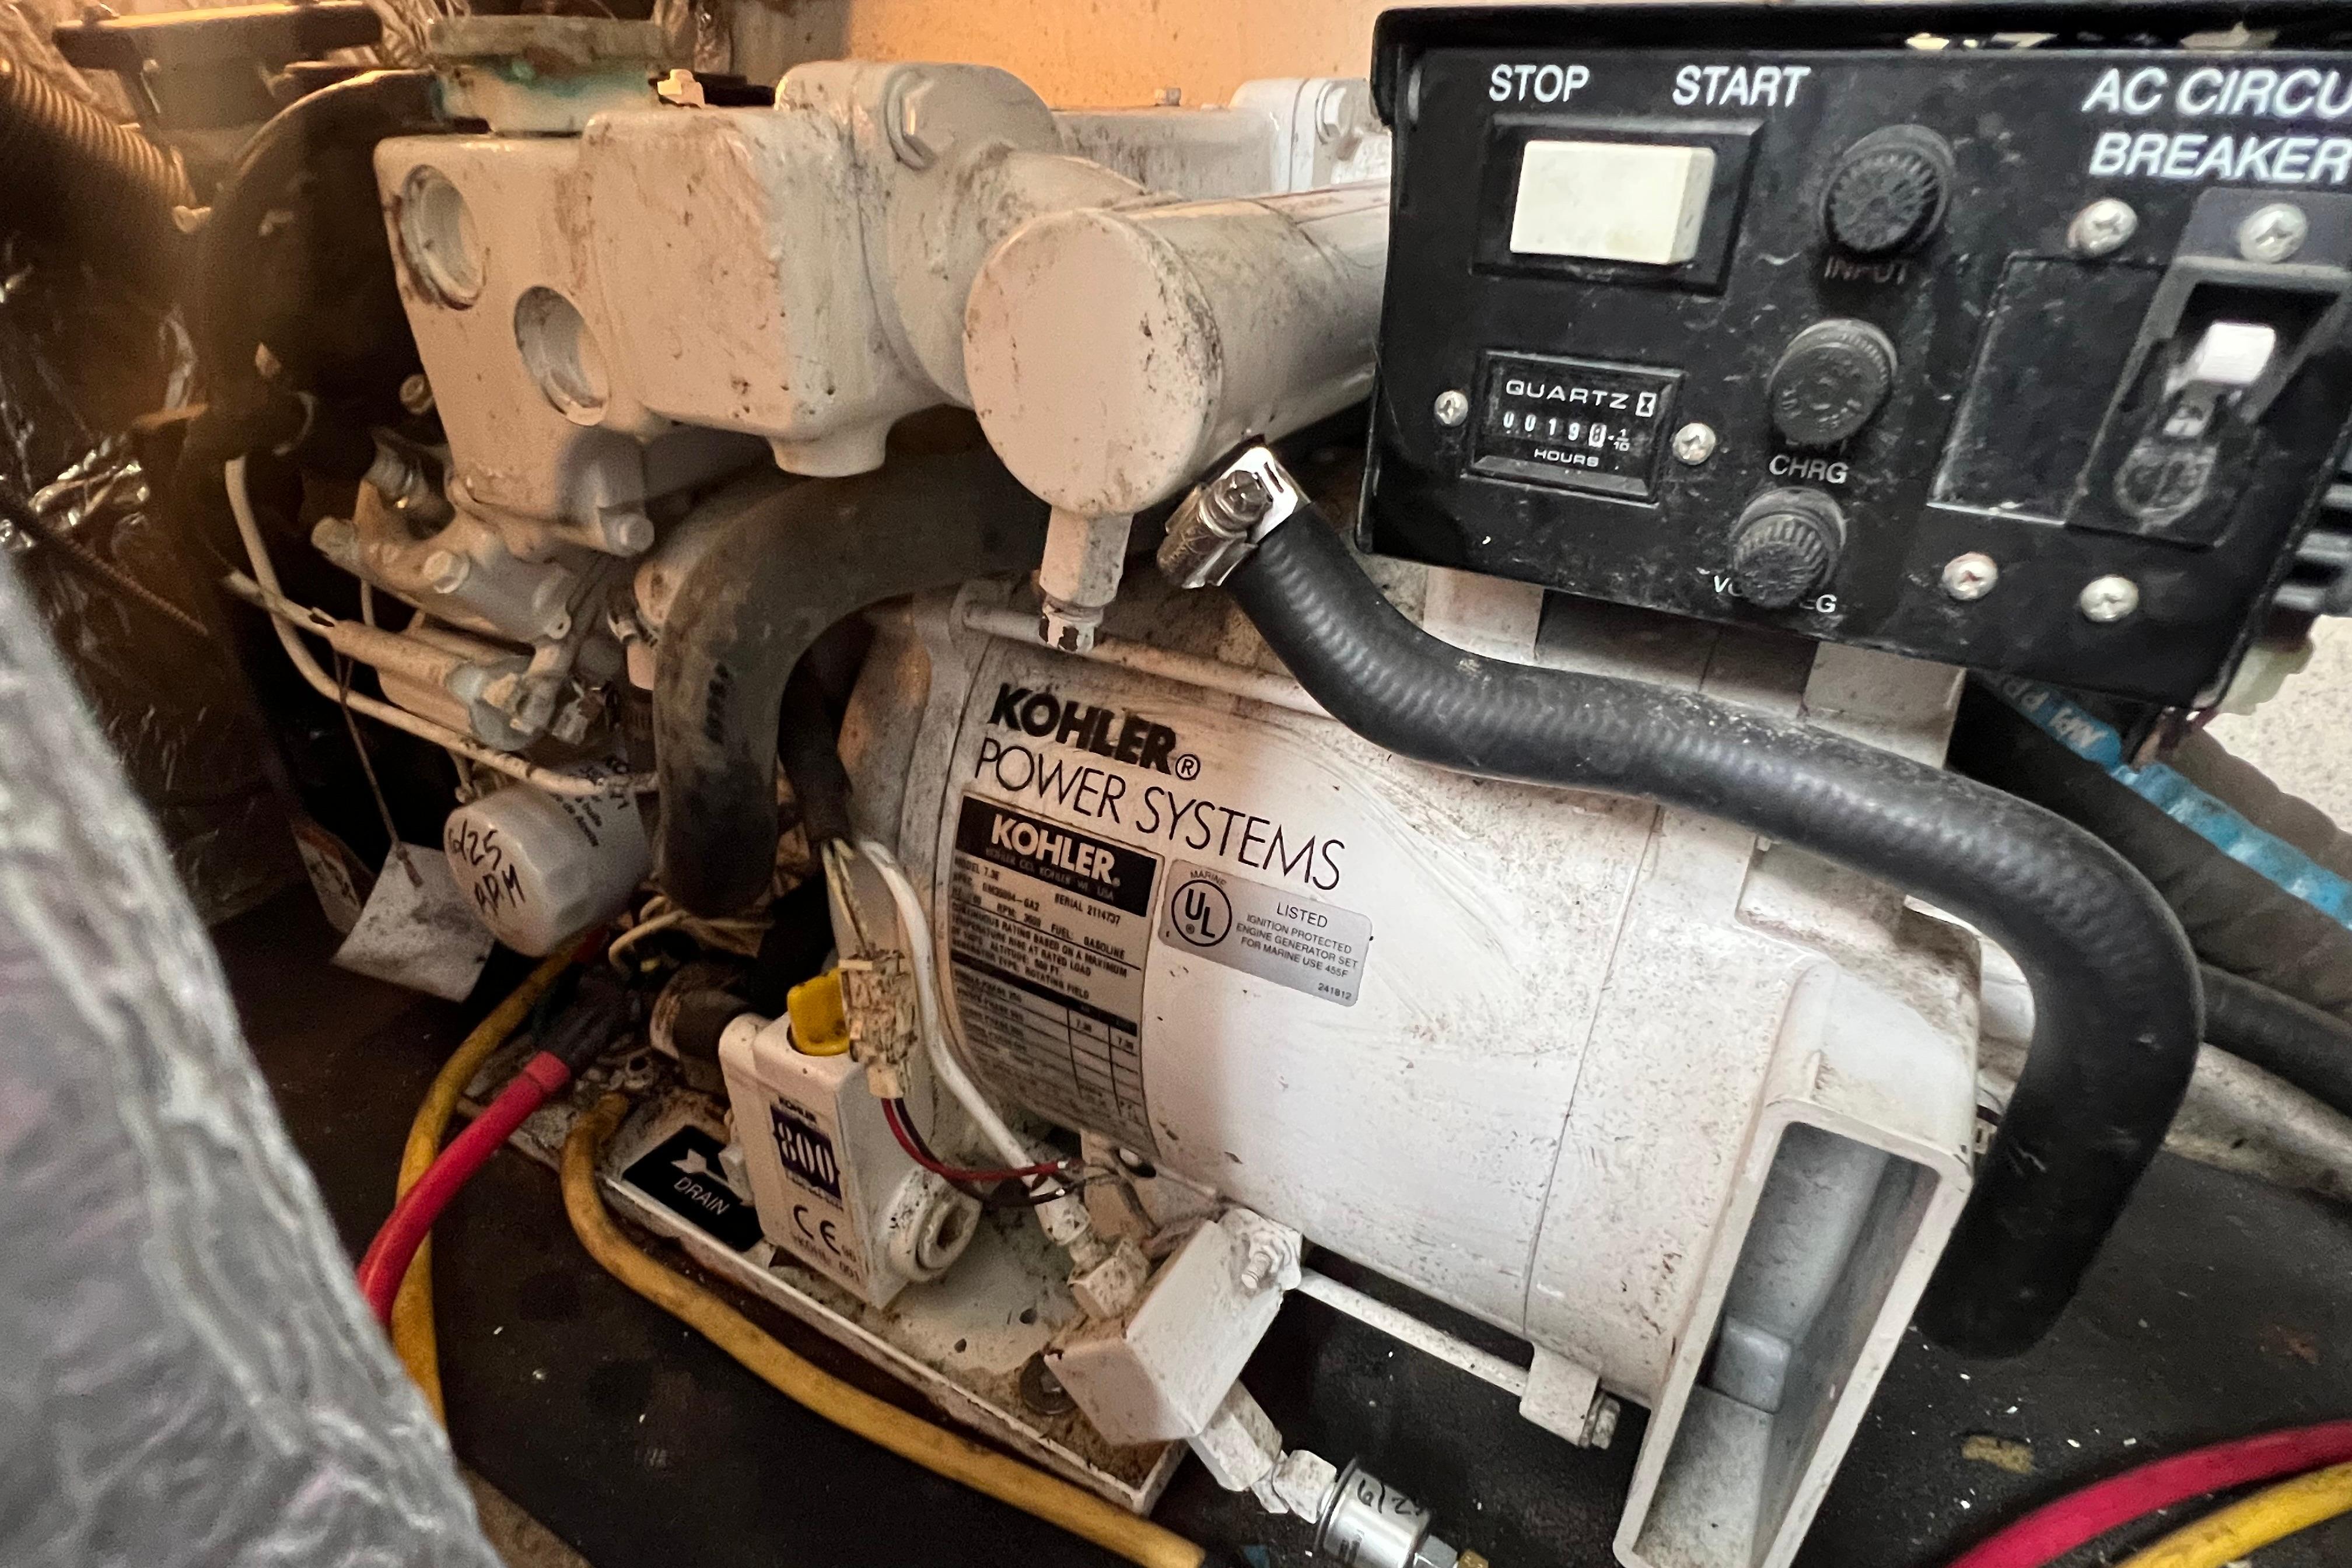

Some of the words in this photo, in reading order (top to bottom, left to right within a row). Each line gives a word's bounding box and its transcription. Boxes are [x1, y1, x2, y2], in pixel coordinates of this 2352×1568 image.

[1489, 64, 1590, 103] STOP
[1672, 65, 1812, 107] START
[2081, 68, 2168, 114] AC
[1506, 379, 1630, 410] QUARTZ
[1534, 448, 1599, 467] HOURS
[1769, 454, 1849, 484] CHRG
[975, 737, 1126, 823] POWER
[1136, 787, 1345, 890] SYSTEMS
[449, 820, 502, 871] 6/25
[1190, 870, 1227, 887] MARINE
[1055, 893, 1083, 912] SERIAL
[1185, 887, 1216, 939] UL
[1277, 902, 1328, 929] LISTED
[1034, 933, 1059, 951] BASED
[1062, 945, 1073, 957] ON
[1076, 950, 1082, 960] A
[1084, 936, 1125, 960] GASOLINE
[1236, 923, 1272, 941] ENGINE
[1275, 935, 1336, 963] GENERATOR
[1338, 955, 1359, 969] SET
[1247, 914, 1290, 935] IGNITION
[1292, 928, 1353, 954] PROTECTED
[1041, 949, 1067, 966] RATED
[1070, 962, 1091, 977] LOAD
[1241, 936, 1261, 951] FOR
[1263, 944, 1301, 964] MARINE
[1303, 957, 1324, 971] USE
[1325, 964, 1349, 978] 455F
[1318, 982, 1352, 1000] 241812
[778, 1122, 835, 1185] 800
[674, 1177, 730, 1215] DRAIN
[793, 1204, 841, 1256] CE
